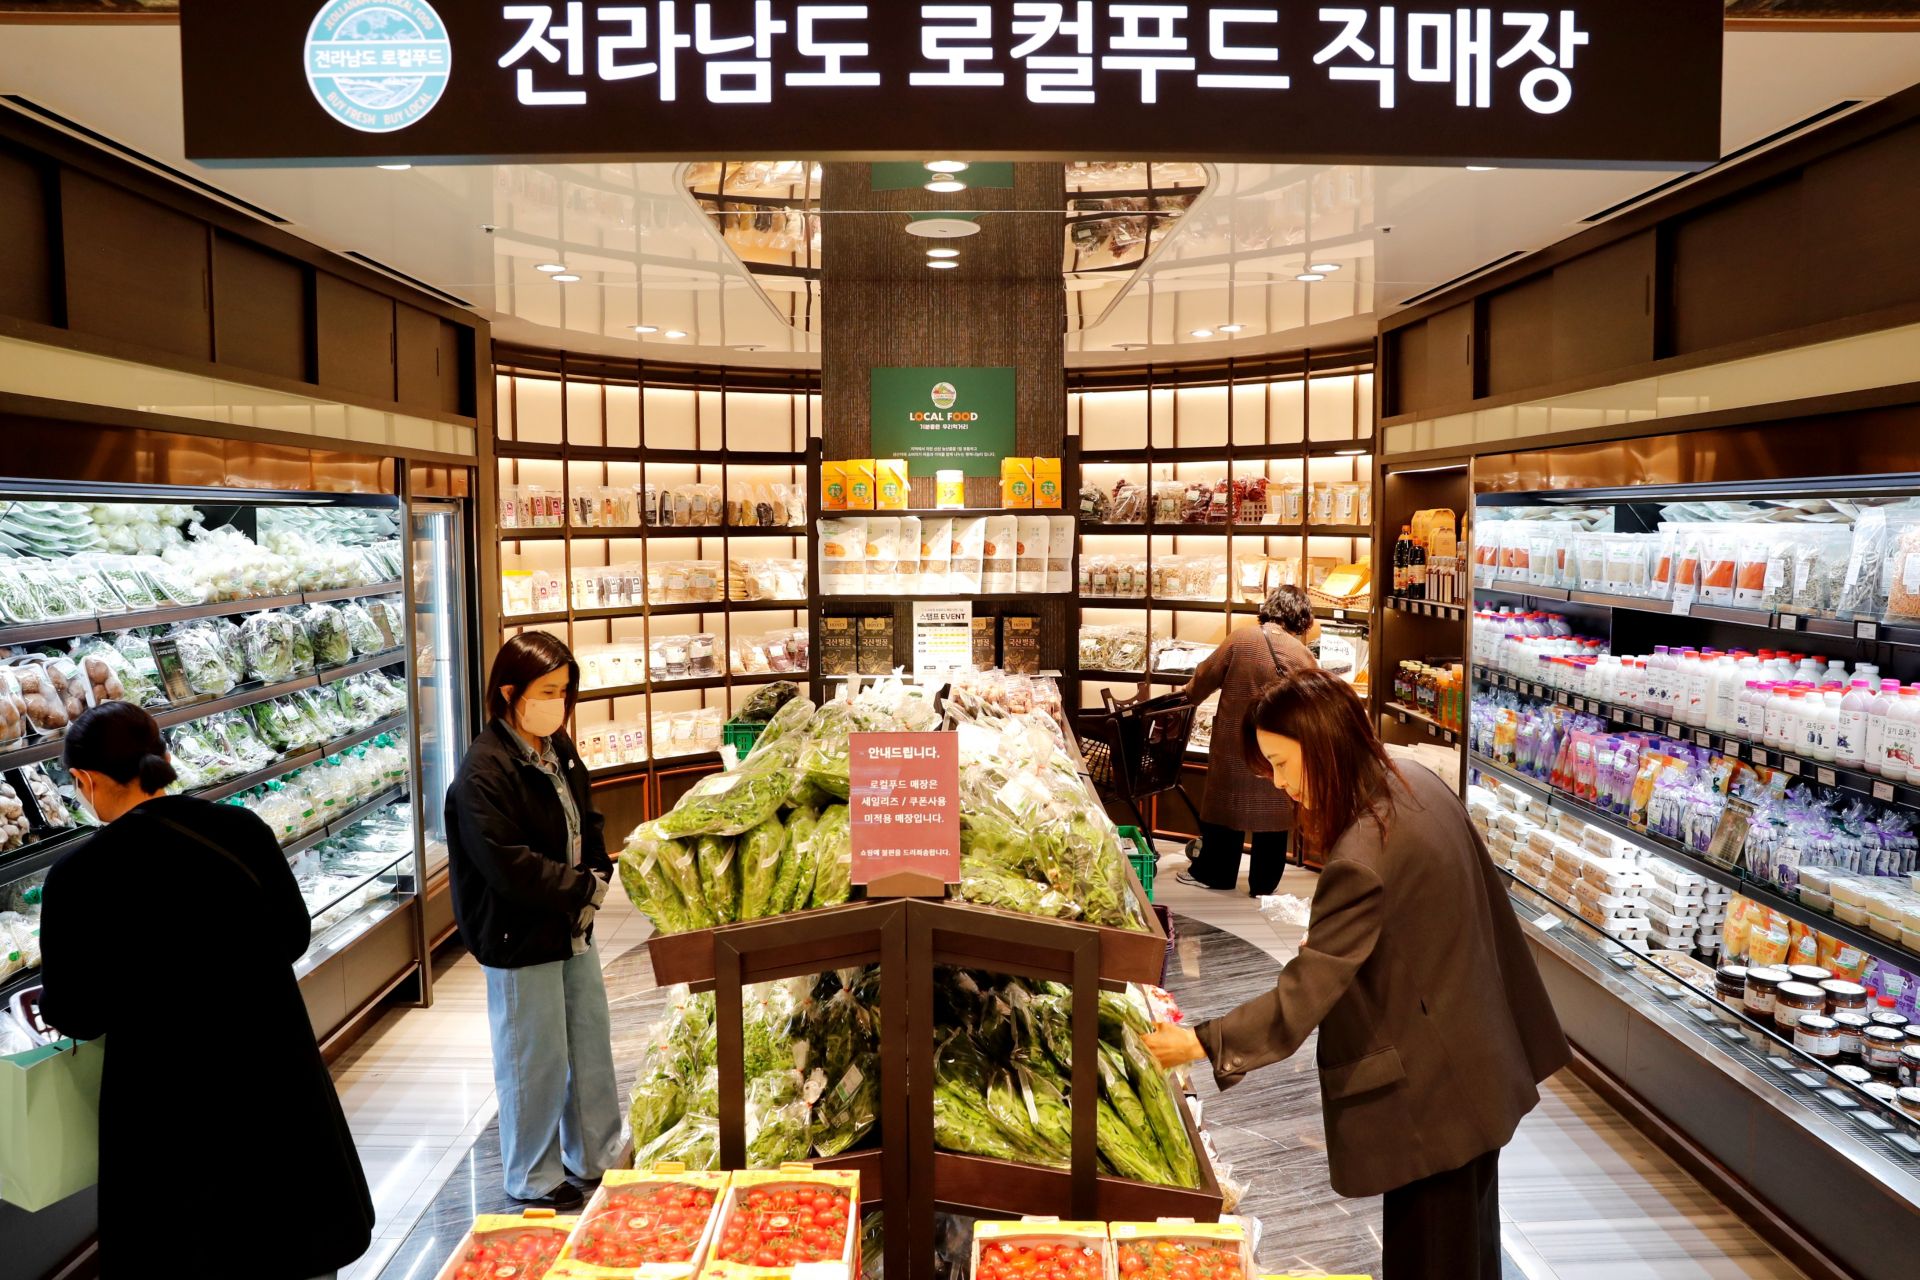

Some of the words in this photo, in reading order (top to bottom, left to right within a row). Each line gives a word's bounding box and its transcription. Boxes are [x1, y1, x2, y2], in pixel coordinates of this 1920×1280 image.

[315, 49, 377, 68] 전라남도
[380, 48, 444, 67] 로컬푸드
[498, 0, 881, 105] 전라남도
[909, 1, 1290, 104] 로컬푸드
[1312, 6, 1589, 115] 직매장
[327, 91, 347, 111] BUY
[346, 106, 376, 125] FRESH
[383, 110, 405, 125] BUY
[405, 93, 432, 116] LOCAL
[909, 412, 944, 421] LOCAL
[947, 412, 978, 421] FOOD
[919, 613, 939, 621] 스탬프
[868, 746, 940, 759] 안내드립니다.
[869, 779, 907, 790] 로컬푸드
[910, 779, 938, 790] 매장은
[861, 796, 899, 807] 세일리즈
[909, 796, 947, 806] 쿠폰사용
[864, 813, 892, 824] 미적용
[895, 813, 945, 824] 매장입니다.
[860, 849, 880, 857] 쇼핑에
[881, 849, 901, 857] 불편을
